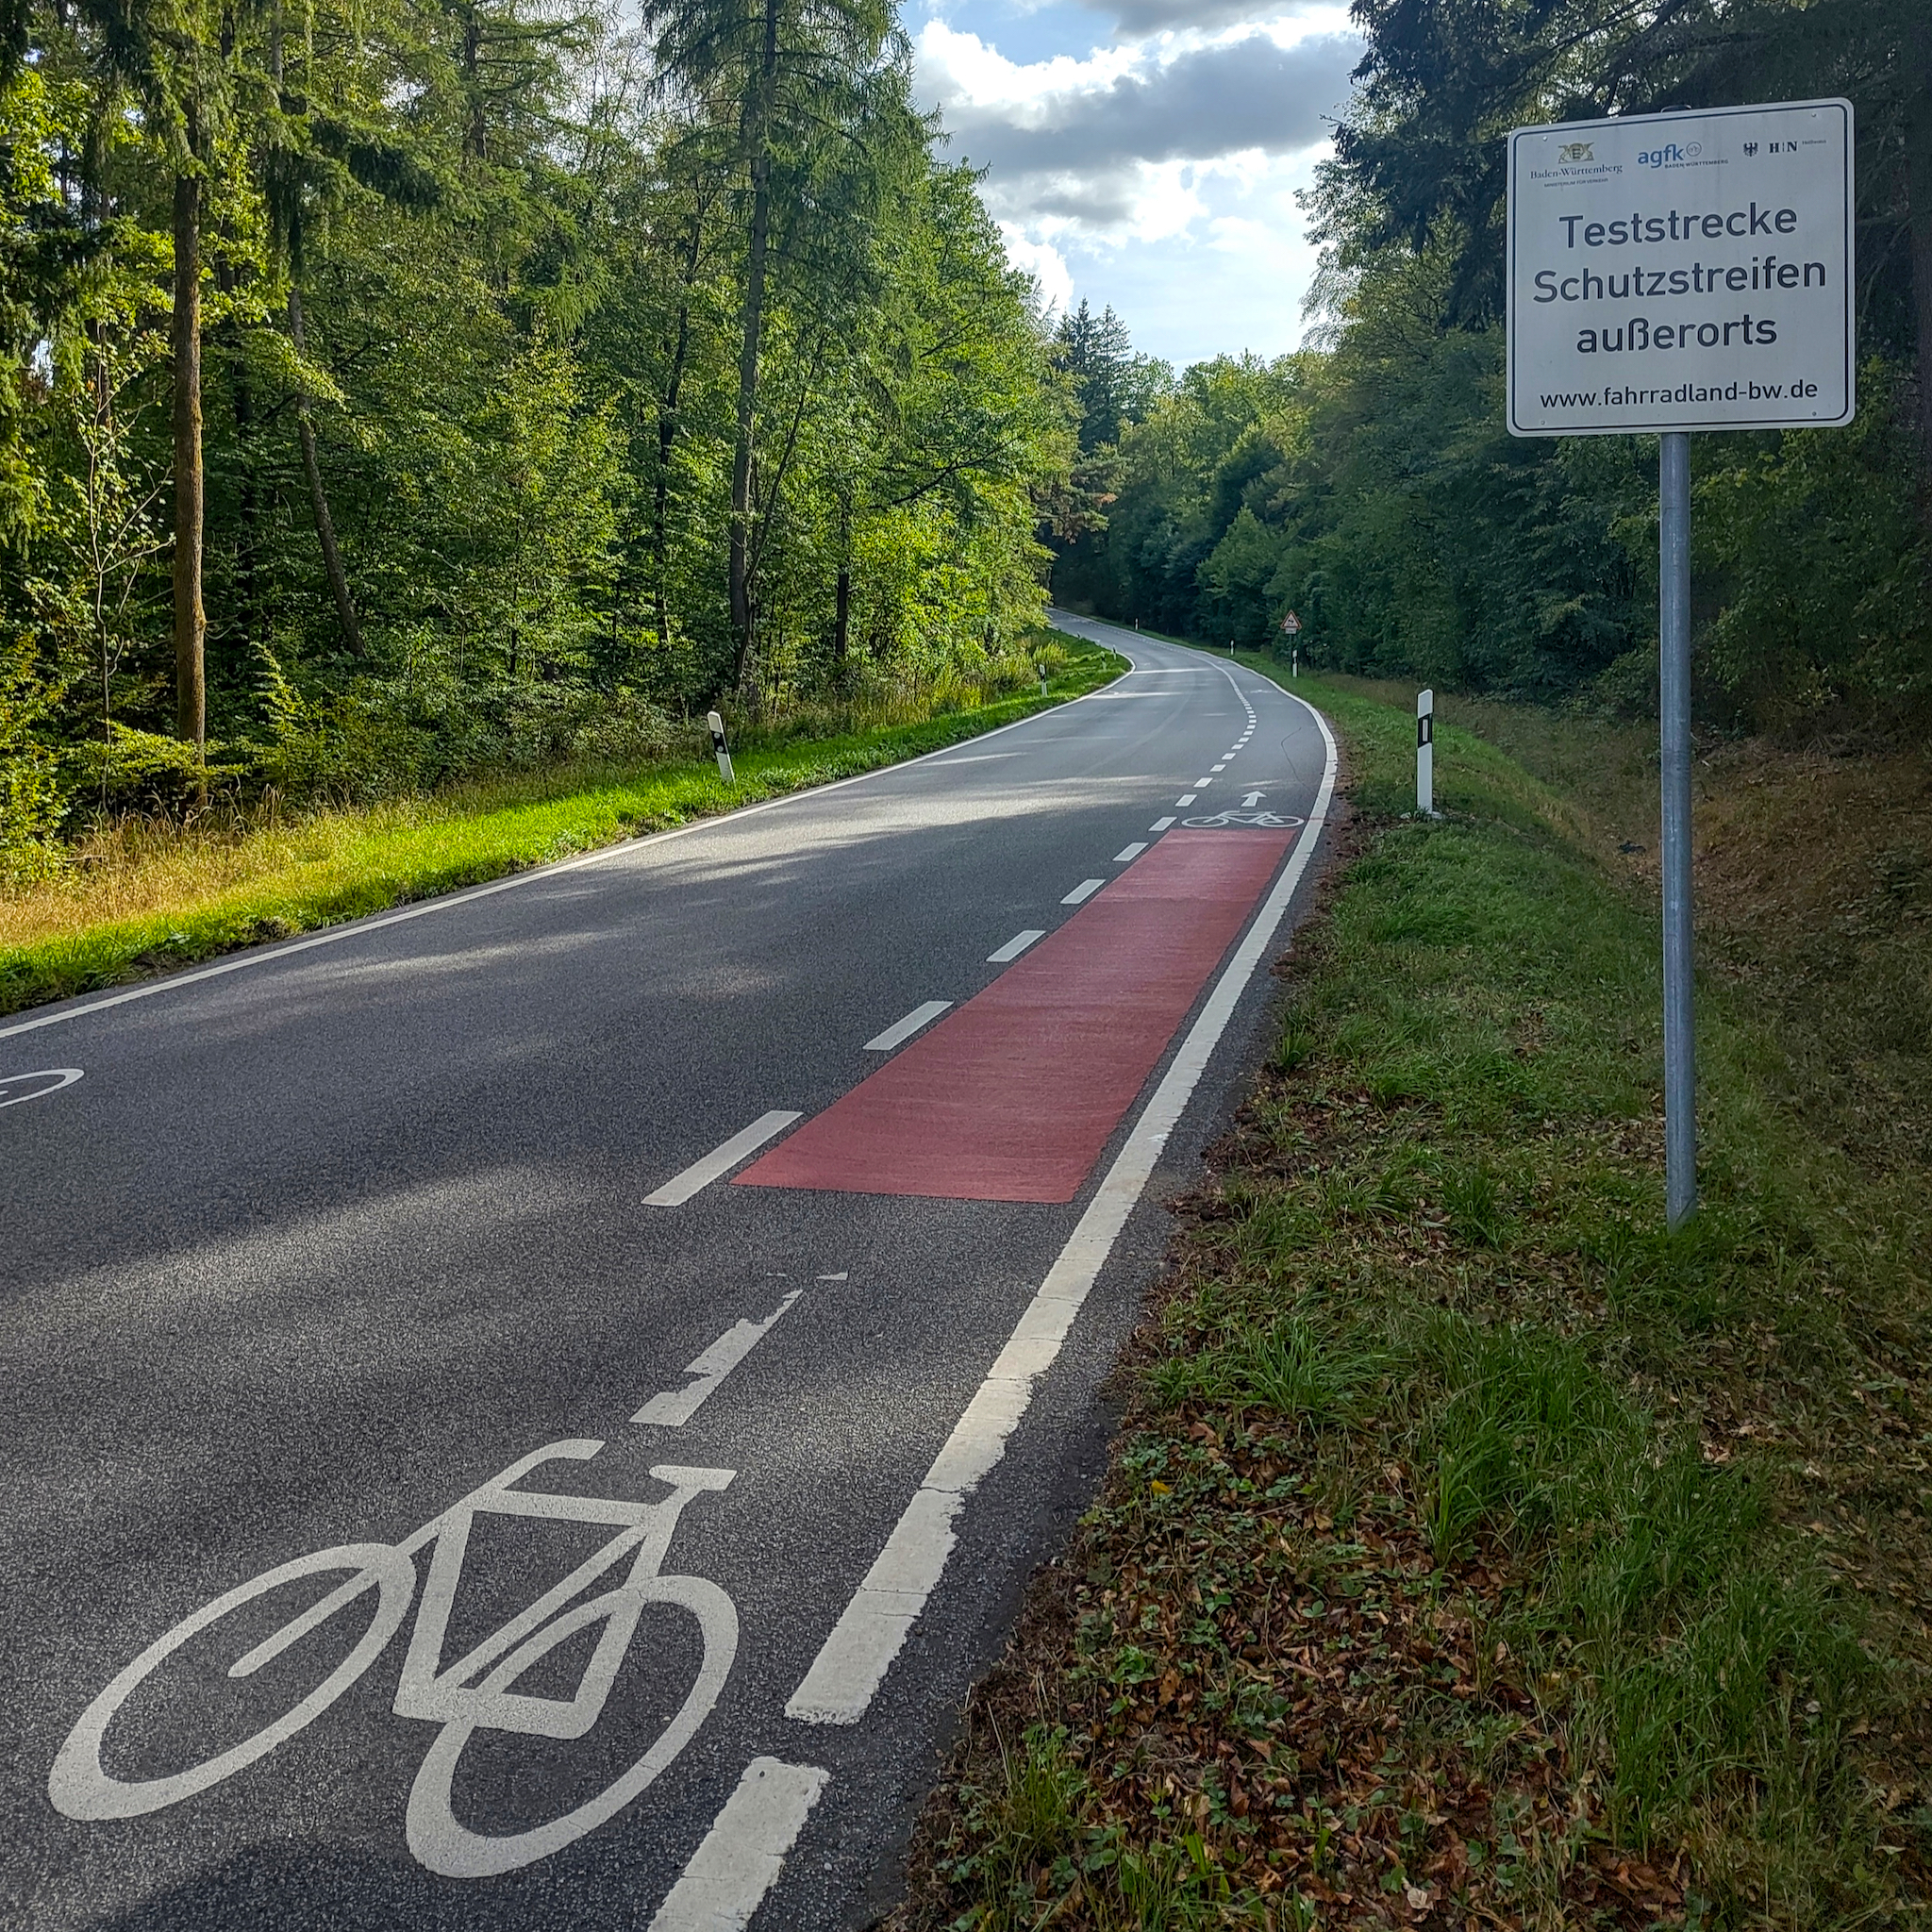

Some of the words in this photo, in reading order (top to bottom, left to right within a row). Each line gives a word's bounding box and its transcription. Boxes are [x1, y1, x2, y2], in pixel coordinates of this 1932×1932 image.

[1530, 163, 1624, 180] Baden-Württemberg
[1638, 143, 1685, 169] agfk
[1558, 202, 1797, 249] Teststrecke
[1533, 256, 1826, 304] Schutzstreifen
[1576, 314, 1778, 354] außerorts
[1541, 379, 1819, 408] www.fahrradland-bw.de
